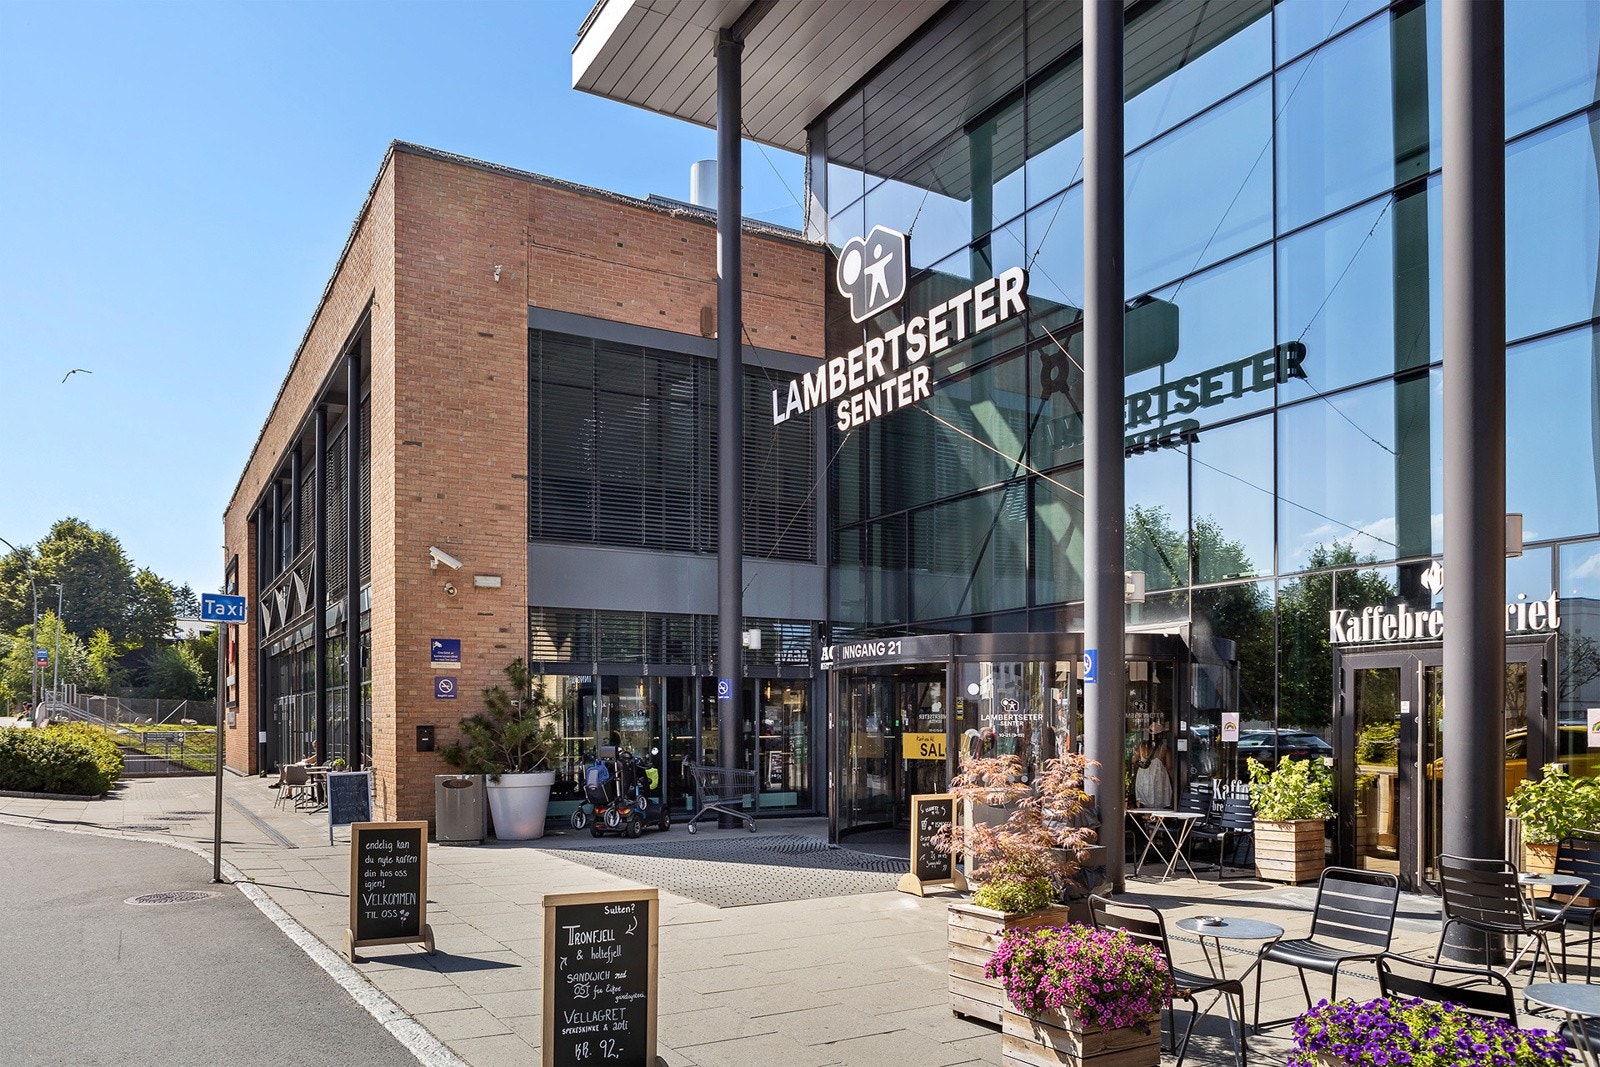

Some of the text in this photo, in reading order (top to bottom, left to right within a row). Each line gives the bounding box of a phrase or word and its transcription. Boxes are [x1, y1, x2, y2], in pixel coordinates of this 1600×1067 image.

[772, 266, 1026, 426] LAMBERTSETER
[836, 365, 932, 432] SENTER
[204, 599, 243, 617] Taxi
[842, 640, 902, 660] INNGANG 21
[920, 743, 947, 757] SAL
[365, 840, 410, 853] endelig kan
[364, 855, 375, 864] du
[364, 869, 377, 877] din
[380, 869, 393, 877] hos
[364, 880, 385, 892] igjen!
[362, 893, 417, 906] VELKOMMEN
[364, 909, 398, 919] TIL OSS
[604, 903, 636, 914] Sulten?
[562, 924, 616, 945] TRONFJELL
[576, 949, 584, 961] &
[566, 970, 611, 983] SANDWICH
[573, 984, 591, 995] OST
[563, 1007, 627, 1024] VELLAGRET
